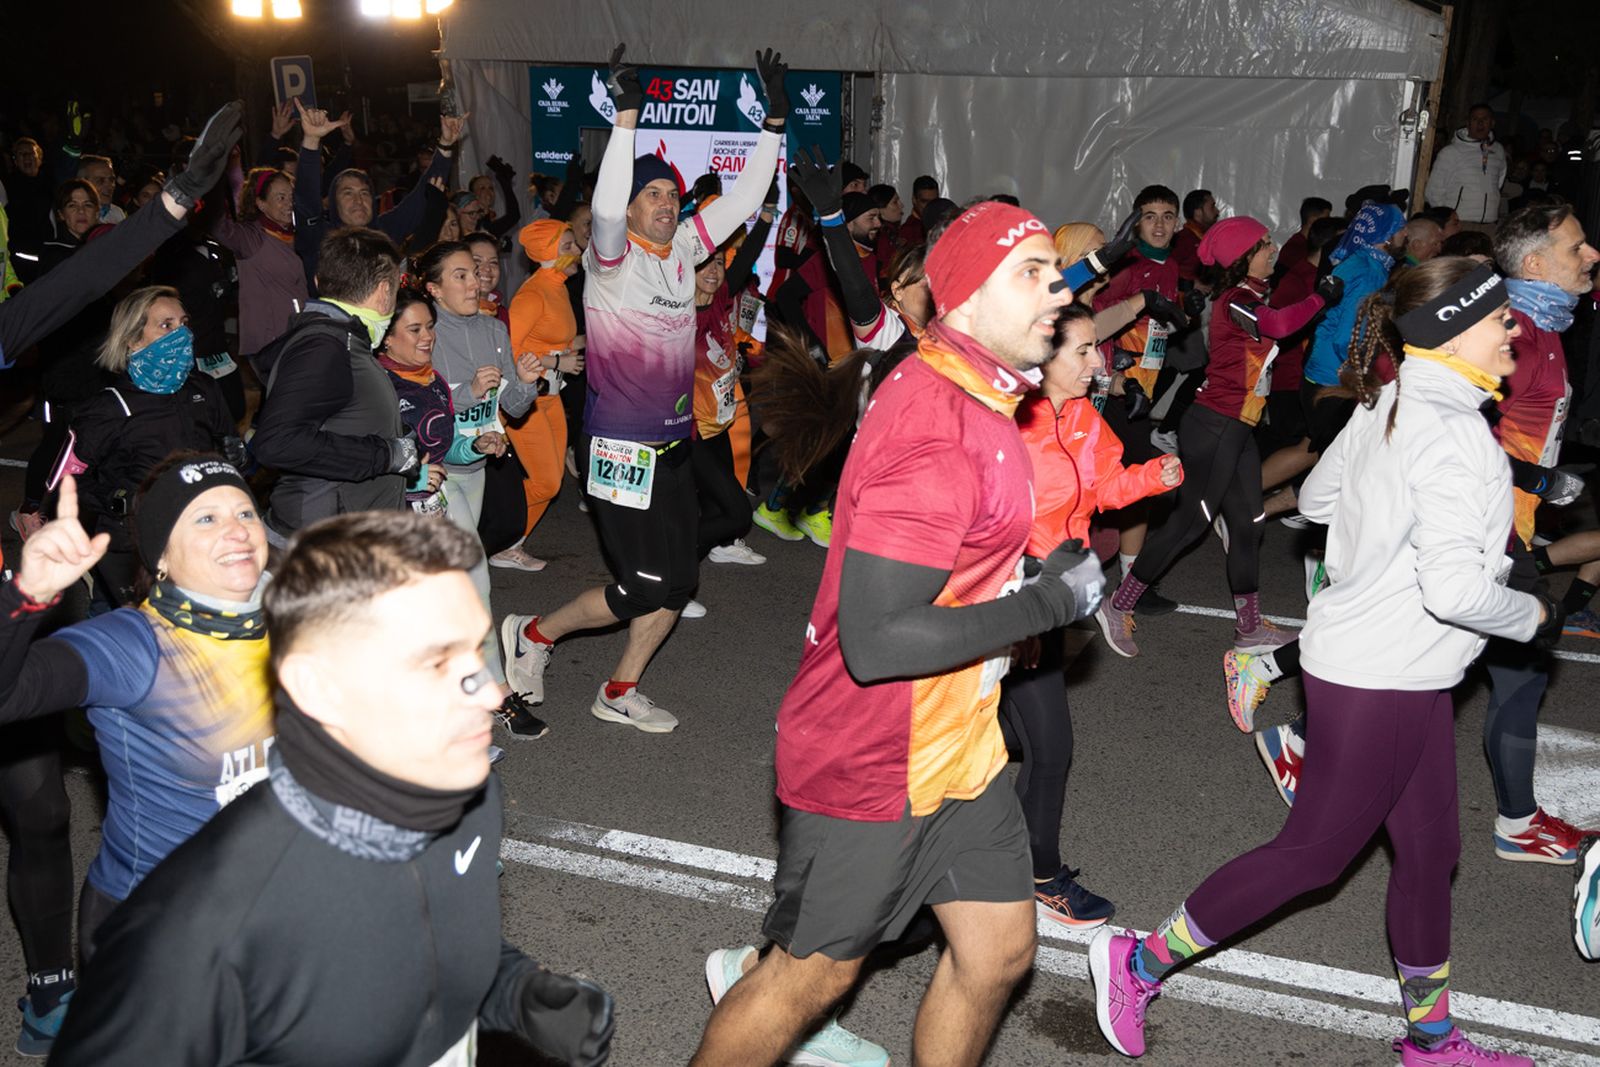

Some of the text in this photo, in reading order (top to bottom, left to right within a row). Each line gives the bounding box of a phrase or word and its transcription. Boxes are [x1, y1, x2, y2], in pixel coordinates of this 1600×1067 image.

[645, 77, 720, 102] 43 SAN
[552, 100, 570, 108] RURAL
[599, 101, 614, 118] 43
[639, 97, 716, 126] ANTÓN
[795, 107, 832, 116] CAJA RURAL
[747, 105, 763, 122] 43
[713, 147, 737, 155] NOCHE
[711, 155, 746, 173] SAN
[596, 458, 646, 487] 12647
